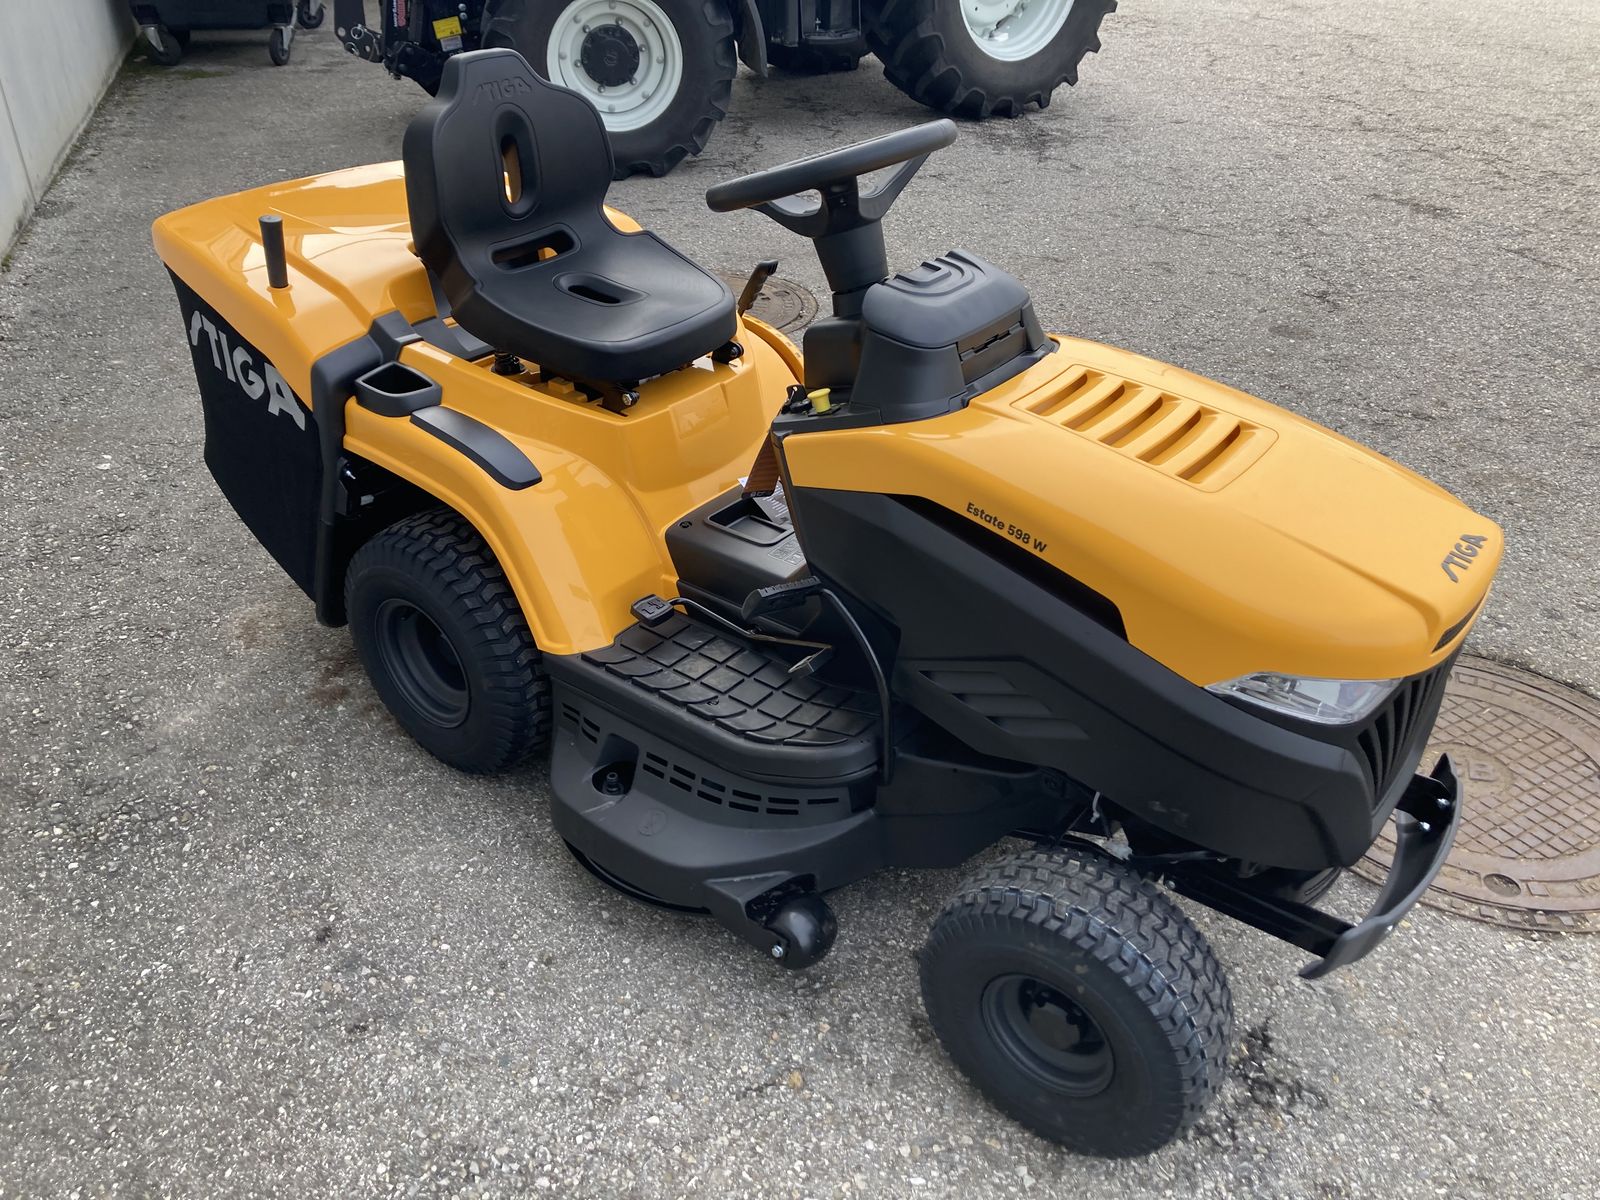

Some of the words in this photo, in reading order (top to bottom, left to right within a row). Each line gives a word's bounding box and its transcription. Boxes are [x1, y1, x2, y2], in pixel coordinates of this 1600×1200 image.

[472, 76, 533, 107] STIGA
[189, 310, 306, 432] STIGA
[966, 502, 1005, 530] Estate
[1007, 524, 1031, 545] 598
[1033, 538, 1048, 553] W
[1440, 533, 1489, 584] STIGA
